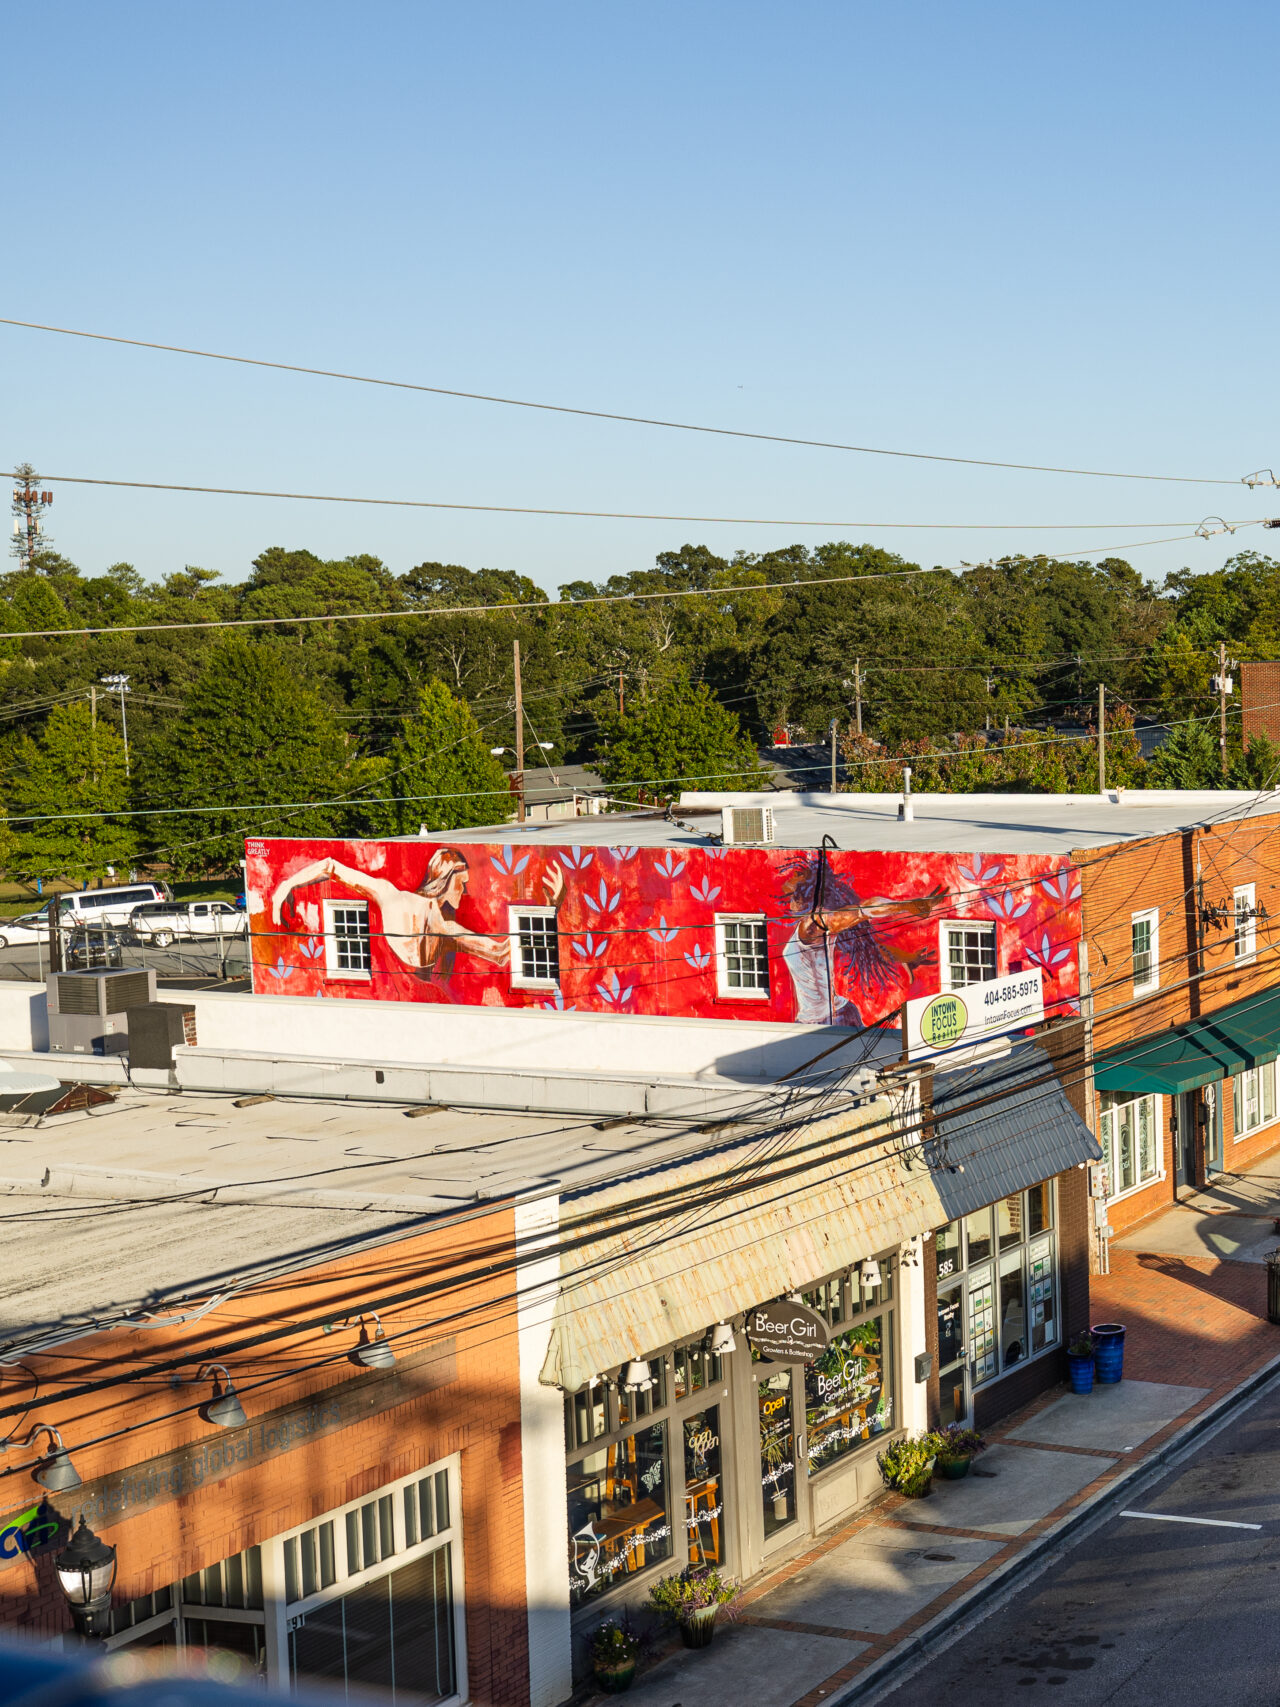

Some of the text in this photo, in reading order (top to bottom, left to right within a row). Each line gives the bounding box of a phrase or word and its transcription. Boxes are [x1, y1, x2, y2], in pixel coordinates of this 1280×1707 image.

[984, 979, 1039, 1006] 404-585-5975
[931, 1000, 957, 1019] INTOWN
[984, 1004, 1033, 1026] IntownFocus.com
[931, 1013, 957, 1033] FOCUS
[932, 1028, 958, 1042] Realty
[939, 1259, 954, 1277] 585
[755, 1315, 817, 1338] Beer Girl
[763, 1345, 783, 1355] Growlers
[789, 1348, 814, 1358] Bottleshop
[817, 1371, 843, 1396] Beer
[842, 1358, 862, 1381] Girl
[764, 1396, 786, 1415] Open
[71, 1402, 341, 1527] redefining global logistics
